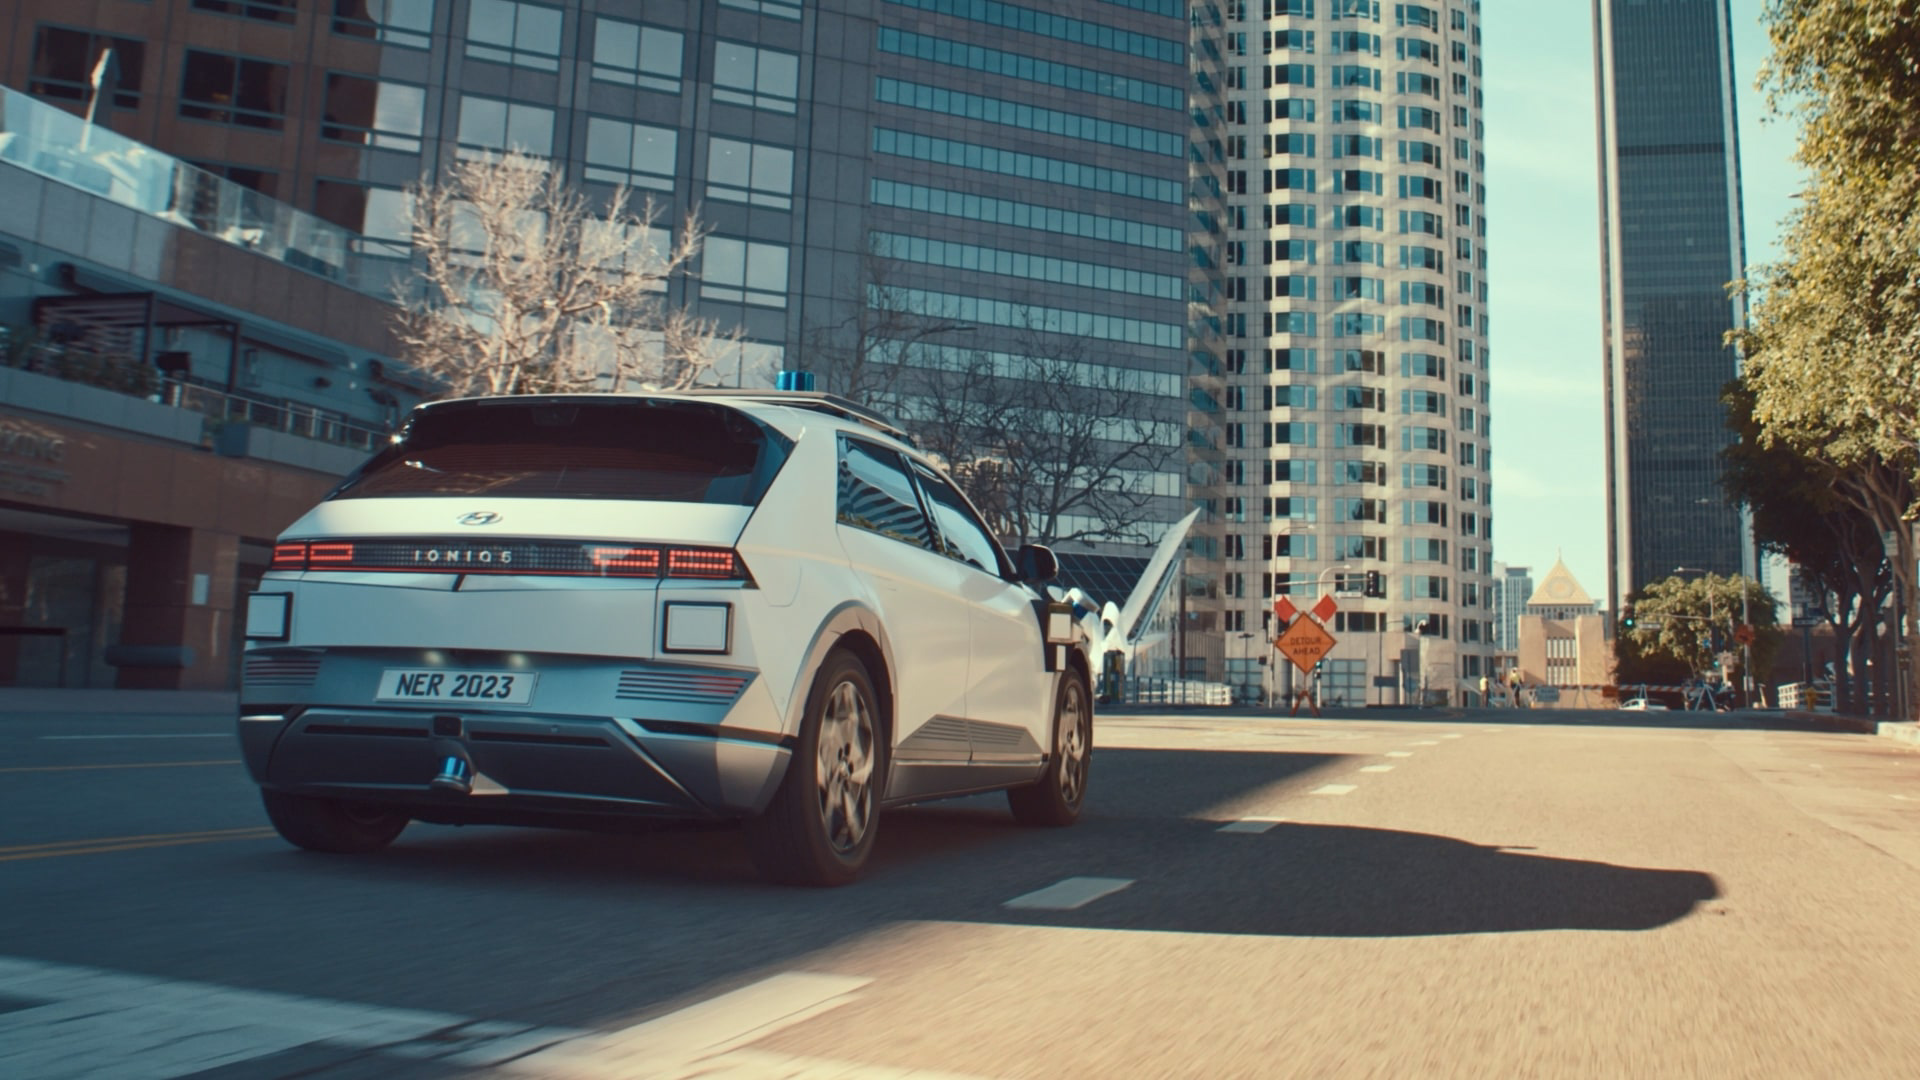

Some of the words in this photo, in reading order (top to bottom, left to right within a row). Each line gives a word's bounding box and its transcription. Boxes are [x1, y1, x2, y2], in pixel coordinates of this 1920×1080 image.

[1290, 637, 1321, 646] DETOUR
[1293, 647, 1320, 655] AHEAD
[395, 673, 444, 696] NER
[451, 674, 514, 699] 2023
